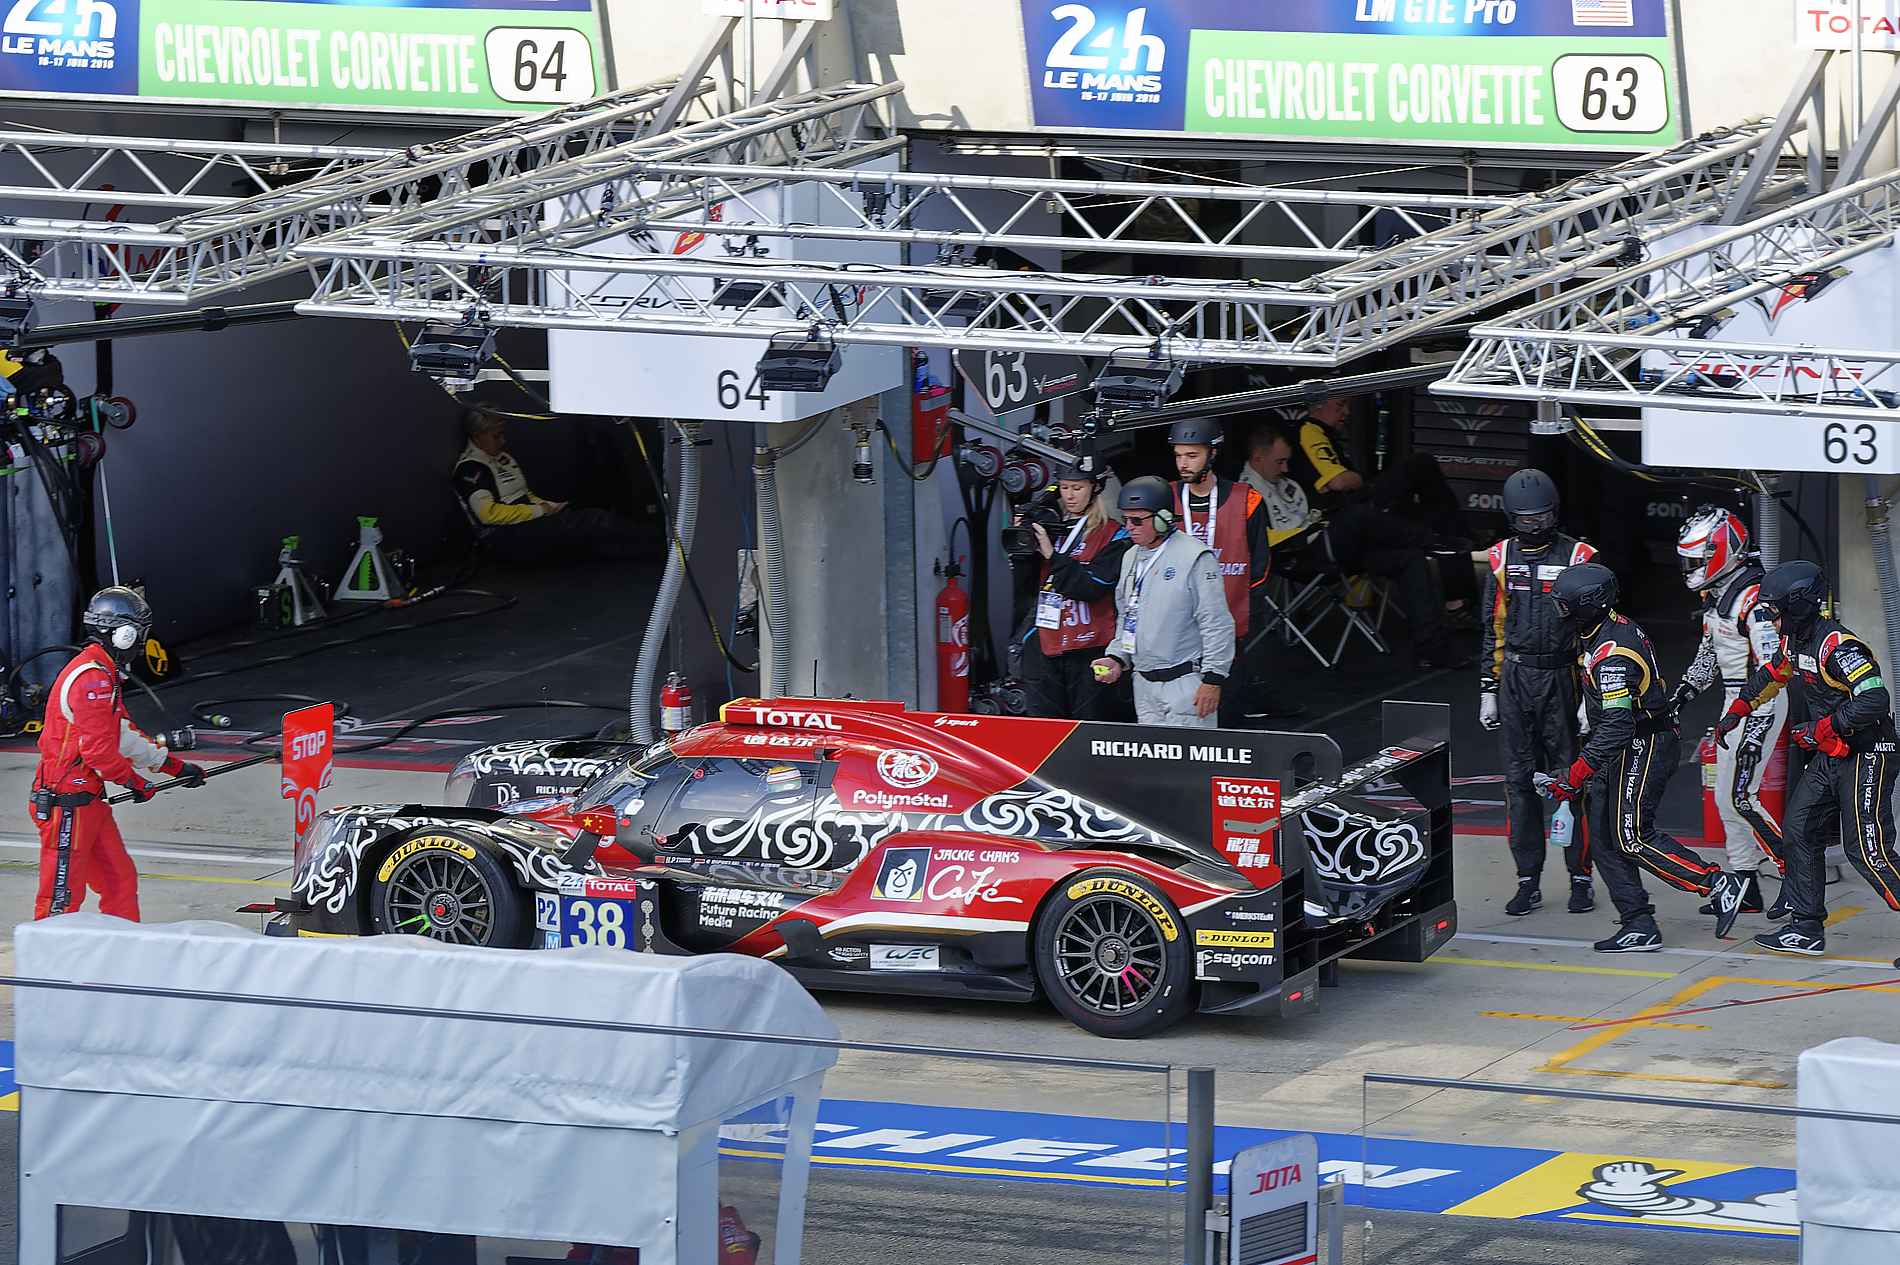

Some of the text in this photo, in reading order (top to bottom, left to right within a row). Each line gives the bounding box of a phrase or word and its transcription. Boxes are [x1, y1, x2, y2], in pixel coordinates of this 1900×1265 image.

[1355, 0, 1396, 22] LM
[1464, 0, 1517, 24] Pro
[1807, 10, 1900, 34] TOTA
[2, 36, 115, 59] LE MANS
[154, 22, 480, 94] CHEVROLET CORVETTE
[513, 39, 568, 92] 64
[1043, 70, 1162, 92] LE MANS
[1203, 57, 1545, 126] CHEVROLET CORVETTE
[1581, 66, 1639, 122] 63
[717, 369, 770, 411] 64
[984, 351, 1028, 409] 63
[1823, 422, 1878, 465] 63
[750, 706, 843, 730] TOTAL
[292, 730, 326, 760] STOP
[1091, 740, 1252, 764] RICHARD MILLE
[1217, 782, 1275, 796] TOTAL
[1626, 776, 1636, 804] JOTA
[391, 837, 469, 865] DUNLOP
[934, 850, 1020, 863] JACKIE CHAN'S
[589, 880, 634, 892] TOTAL
[927, 865, 1024, 905] Café
[537, 897, 557, 926] P2
[699, 902, 780, 921] Future Racing
[1088, 879, 1174, 930] DUNLOP
[569, 900, 626, 950] 38
[699, 914, 734, 929] Media
[1211, 934, 1271, 943] DUNLOP
[885, 948, 936, 960] WEC
[1213, 952, 1274, 968] sagcom
[1249, 1163, 1302, 1196] JOTA
